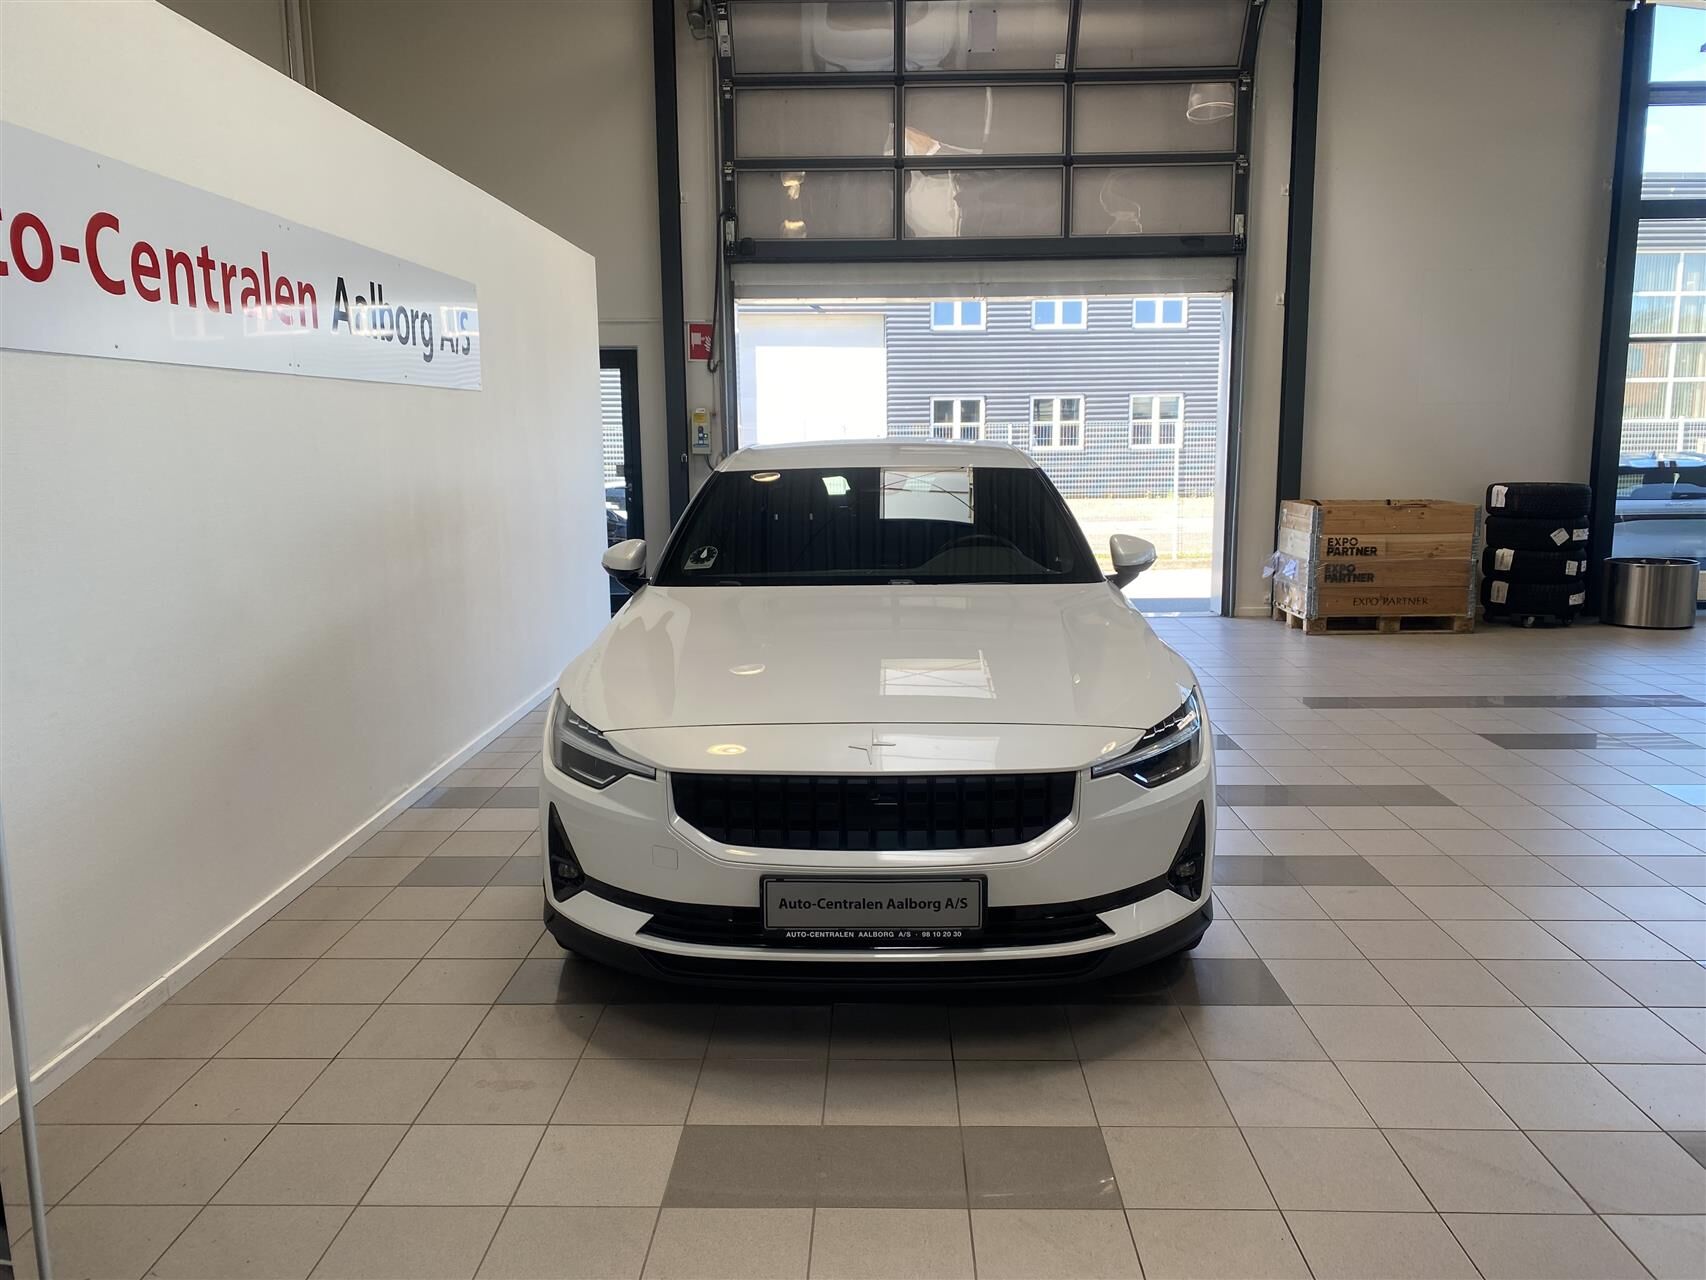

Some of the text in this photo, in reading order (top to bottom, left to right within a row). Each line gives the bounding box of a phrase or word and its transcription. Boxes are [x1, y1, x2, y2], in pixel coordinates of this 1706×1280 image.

[331, 276, 434, 363] Aalborg
[1327, 537, 1359, 547] EXPO
[1326, 546, 1378, 557] PARTNER
[1324, 563, 1356, 573] EXPO
[1324, 572, 1375, 583] PARTNER
[1353, 597, 1429, 606] EXPO PARTNER
[778, 897, 968, 912] Auto-Centralen Aalborg A/S
